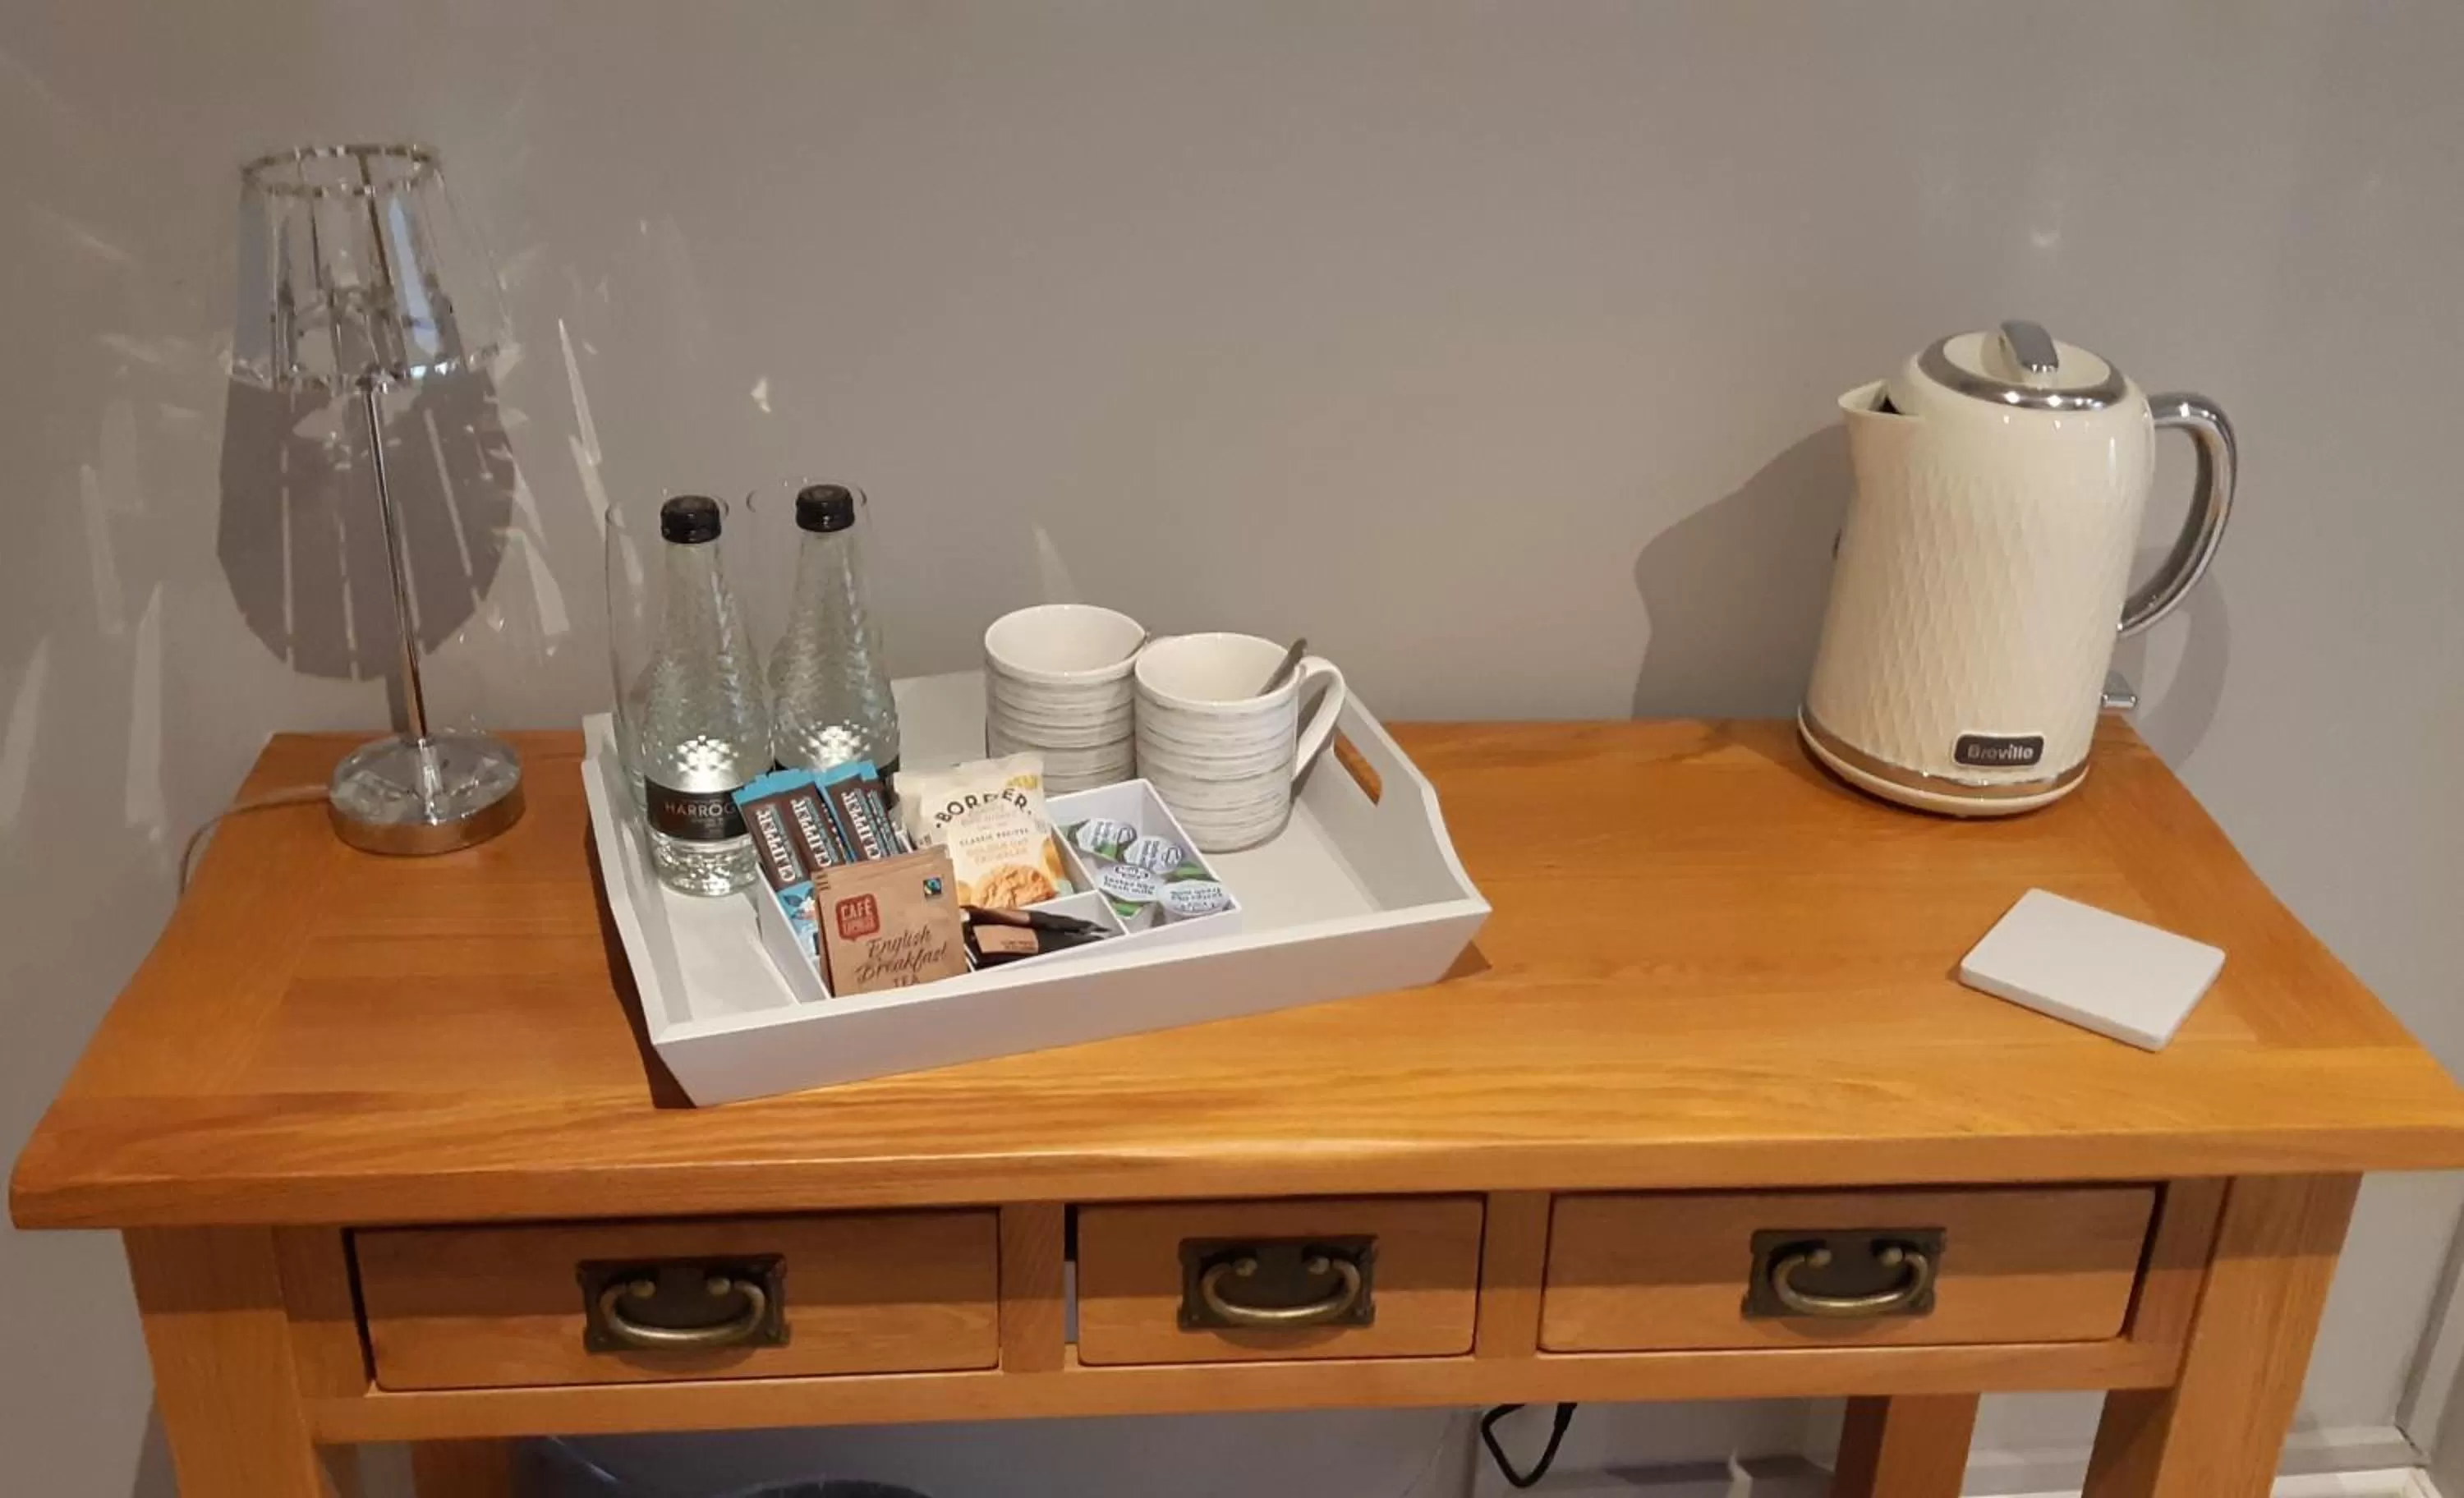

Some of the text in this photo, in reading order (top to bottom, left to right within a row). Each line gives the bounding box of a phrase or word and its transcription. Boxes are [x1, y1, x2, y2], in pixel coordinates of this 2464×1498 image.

[1967, 742, 2034, 760] Breville
[756, 809, 796, 882] CLIPPER
[790, 798, 832, 867] CLIPPER
[841, 791, 881, 860] CLIPPER
[854, 940, 947, 985] Breakfast
[866, 924, 931, 959] English
